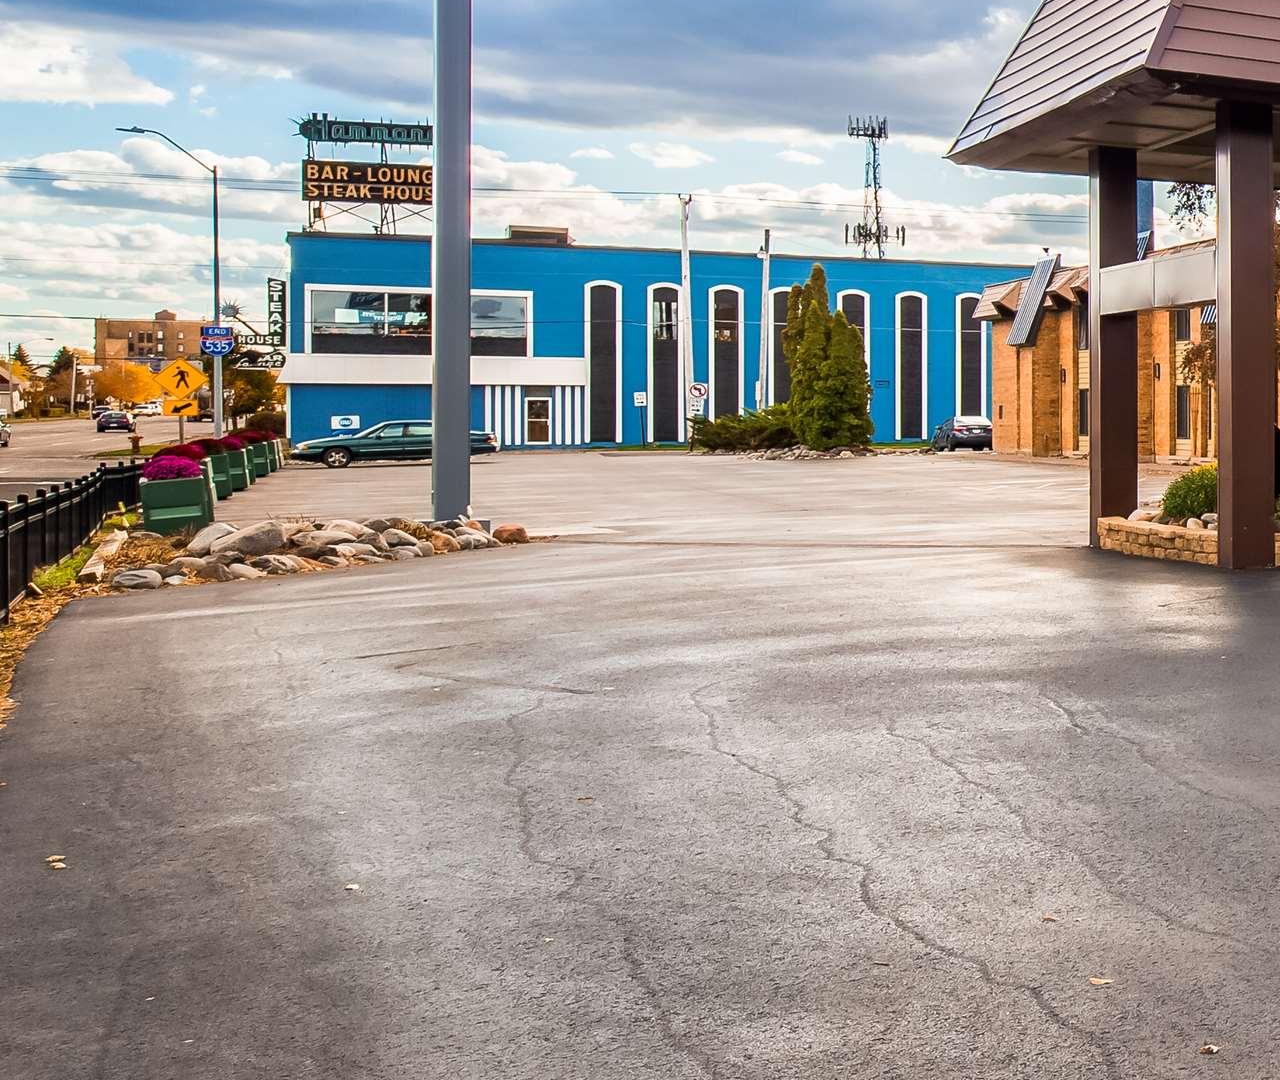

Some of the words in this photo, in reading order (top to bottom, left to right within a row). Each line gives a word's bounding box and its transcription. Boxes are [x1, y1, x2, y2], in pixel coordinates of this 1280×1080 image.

[306, 113, 433, 144] Hammon
[307, 183, 372, 199] STEAK
[383, 185, 433, 202] HOUS
[269, 280, 283, 333] STEAK
[205, 340, 229, 352] 535
[238, 335, 281, 345] HOUSE
